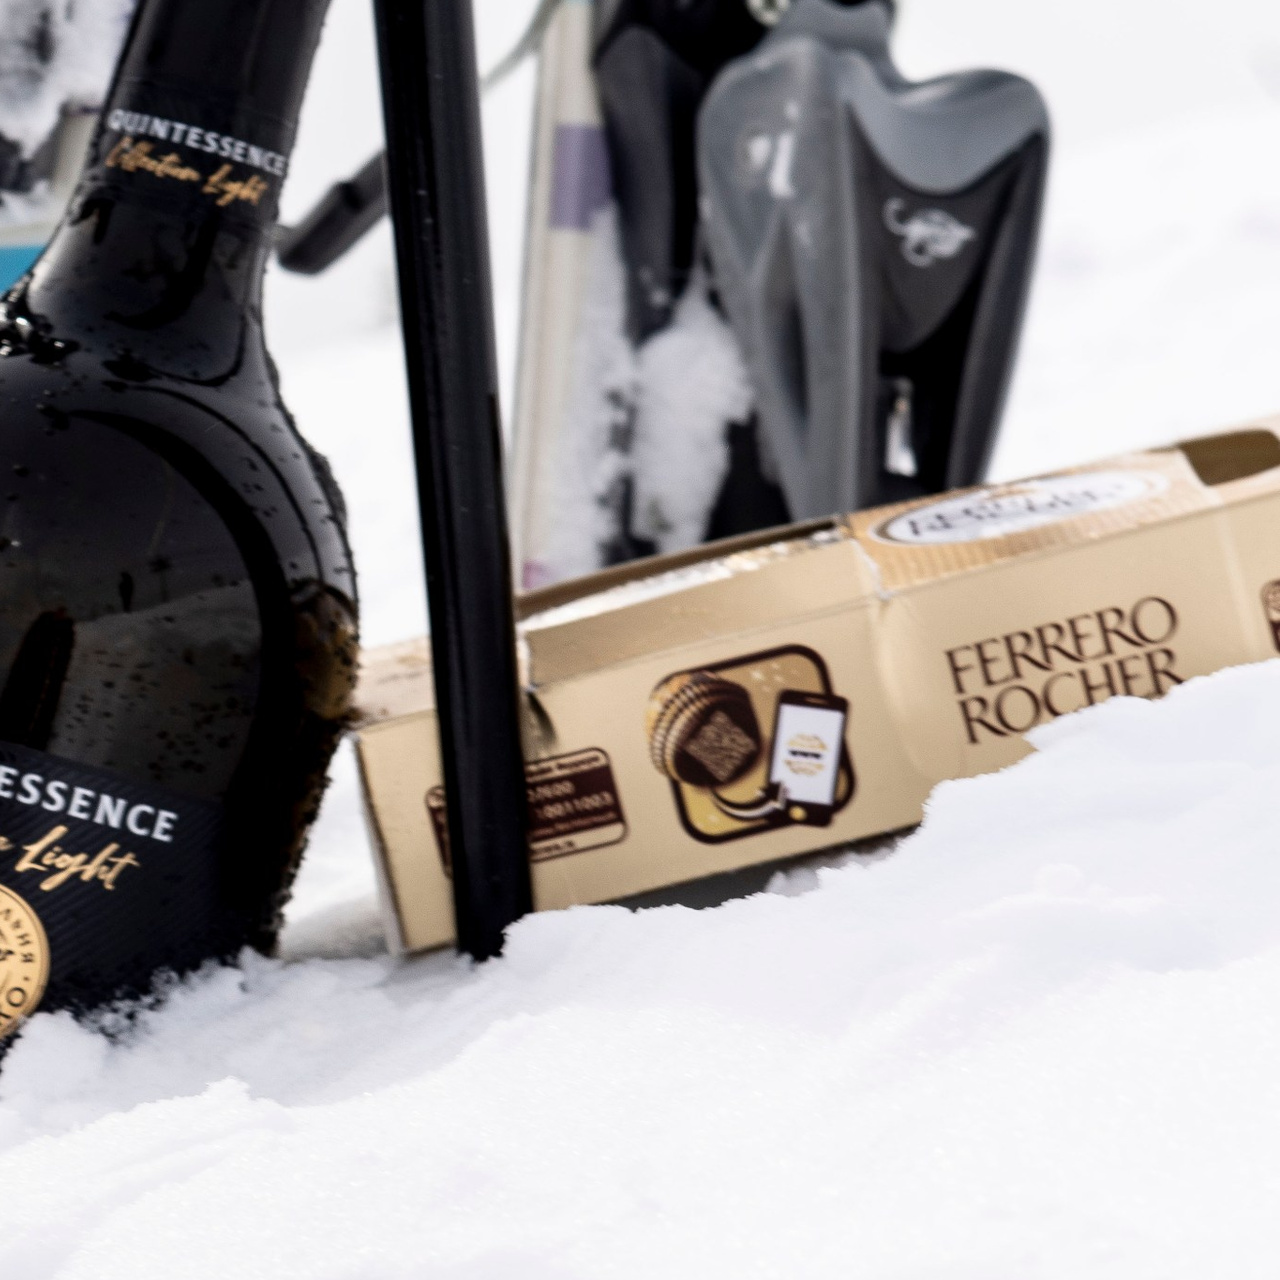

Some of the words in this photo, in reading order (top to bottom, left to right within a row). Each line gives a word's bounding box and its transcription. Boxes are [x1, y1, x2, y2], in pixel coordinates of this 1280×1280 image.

[107, 108, 288, 177] QUINTESSENCE
[945, 596, 1179, 695] FERRERO
[958, 647, 1184, 744] ROCHER
[14, 824, 140, 892] Light
